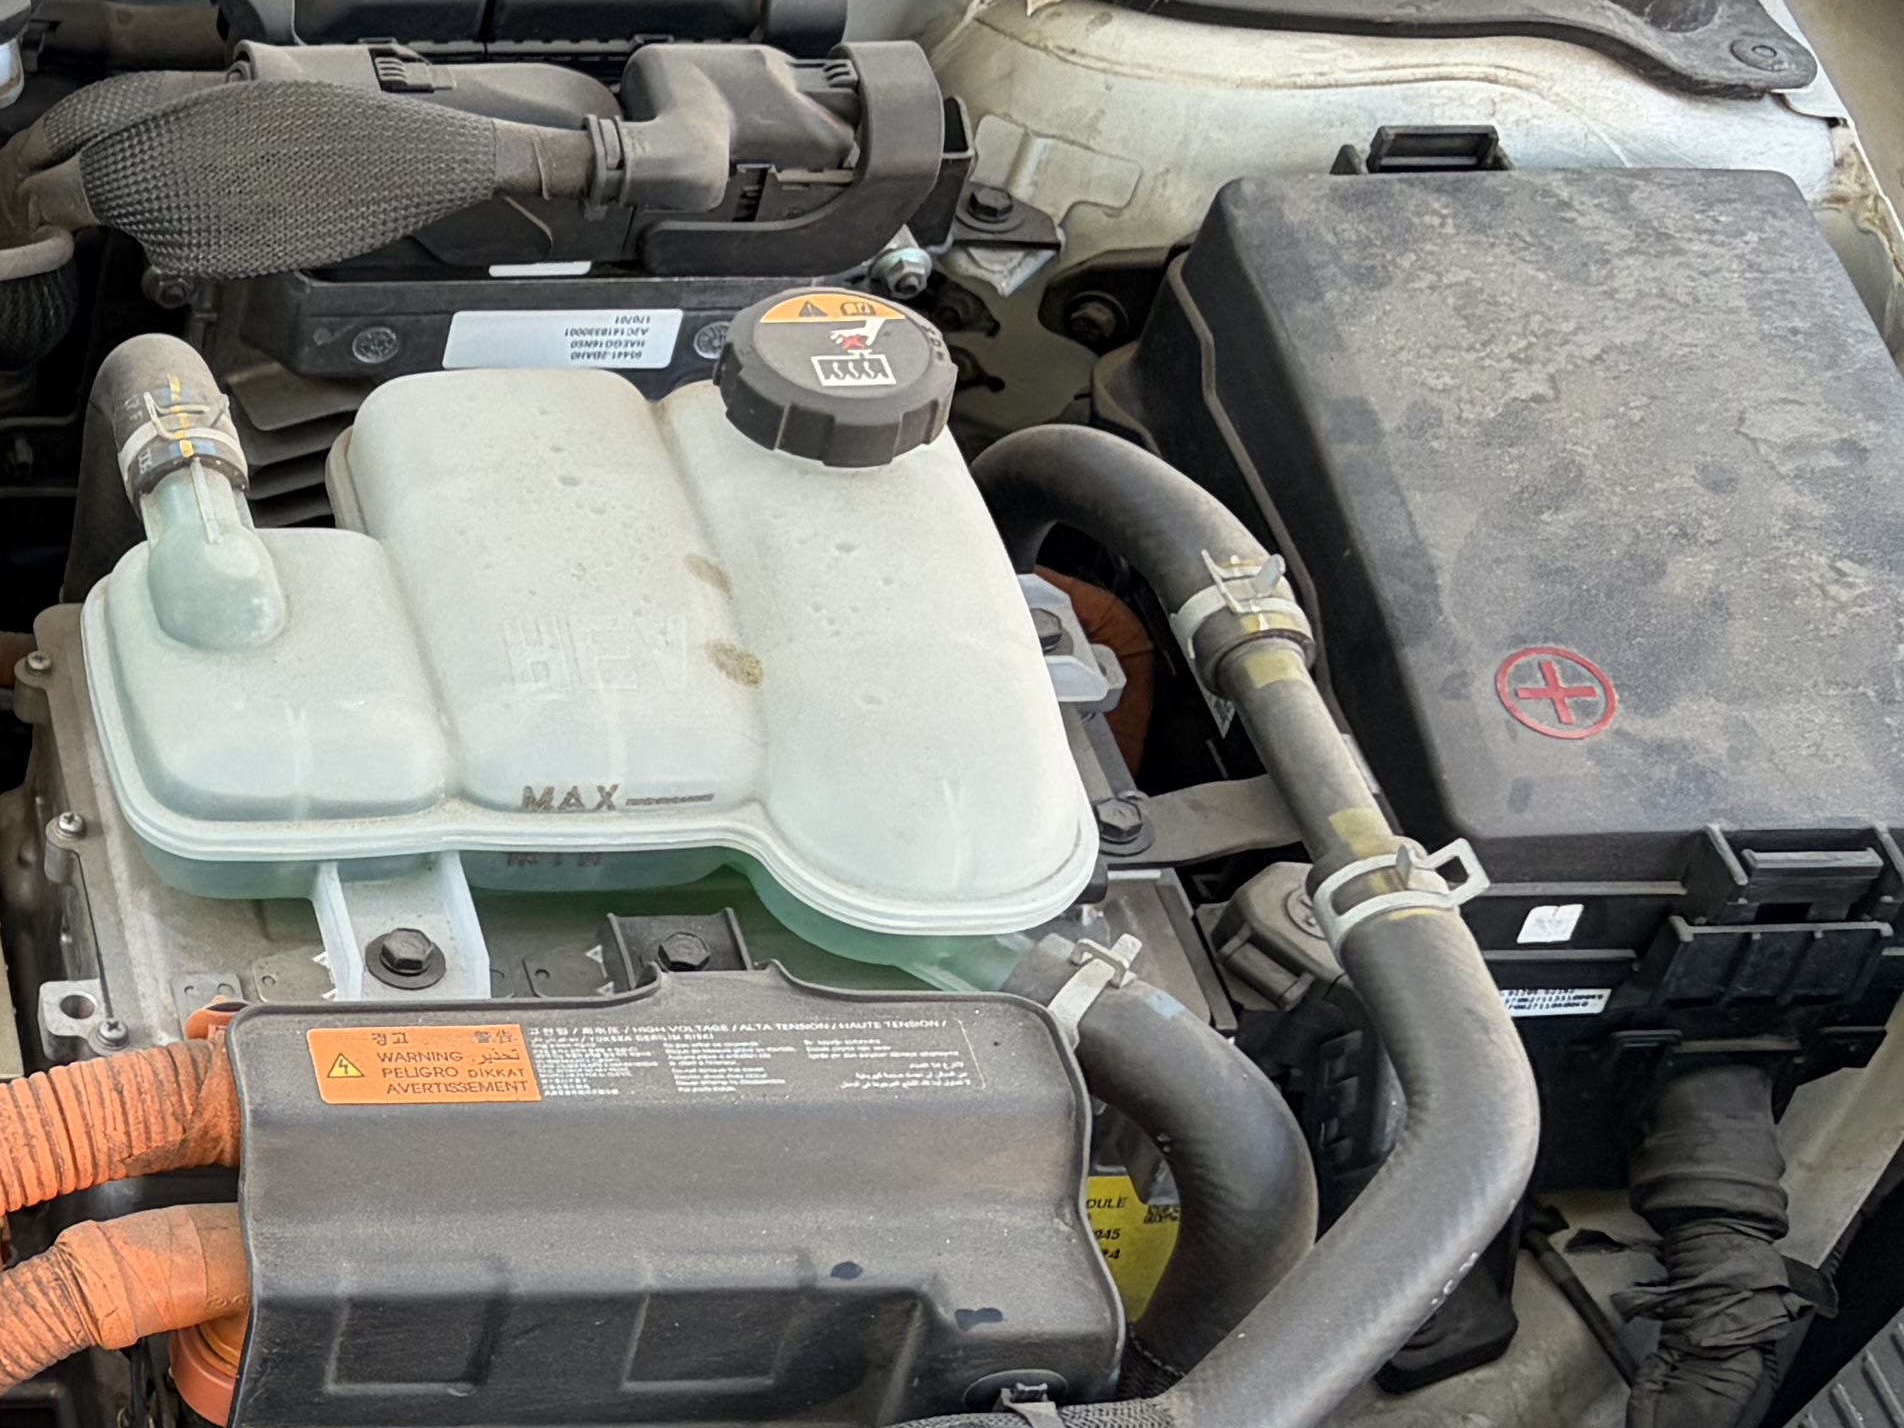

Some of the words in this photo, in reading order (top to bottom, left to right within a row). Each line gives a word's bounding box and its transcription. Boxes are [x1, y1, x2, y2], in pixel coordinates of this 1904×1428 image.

[520, 784, 620, 812] MAX
[669, 1024, 729, 1032] VOLTAGE
[776, 1022, 829, 1031] TENSION
[377, 1052, 464, 1063] WARNING
[382, 1067, 459, 1079] PELIGRO
[387, 1081, 528, 1095] AVERTISSEMENT
